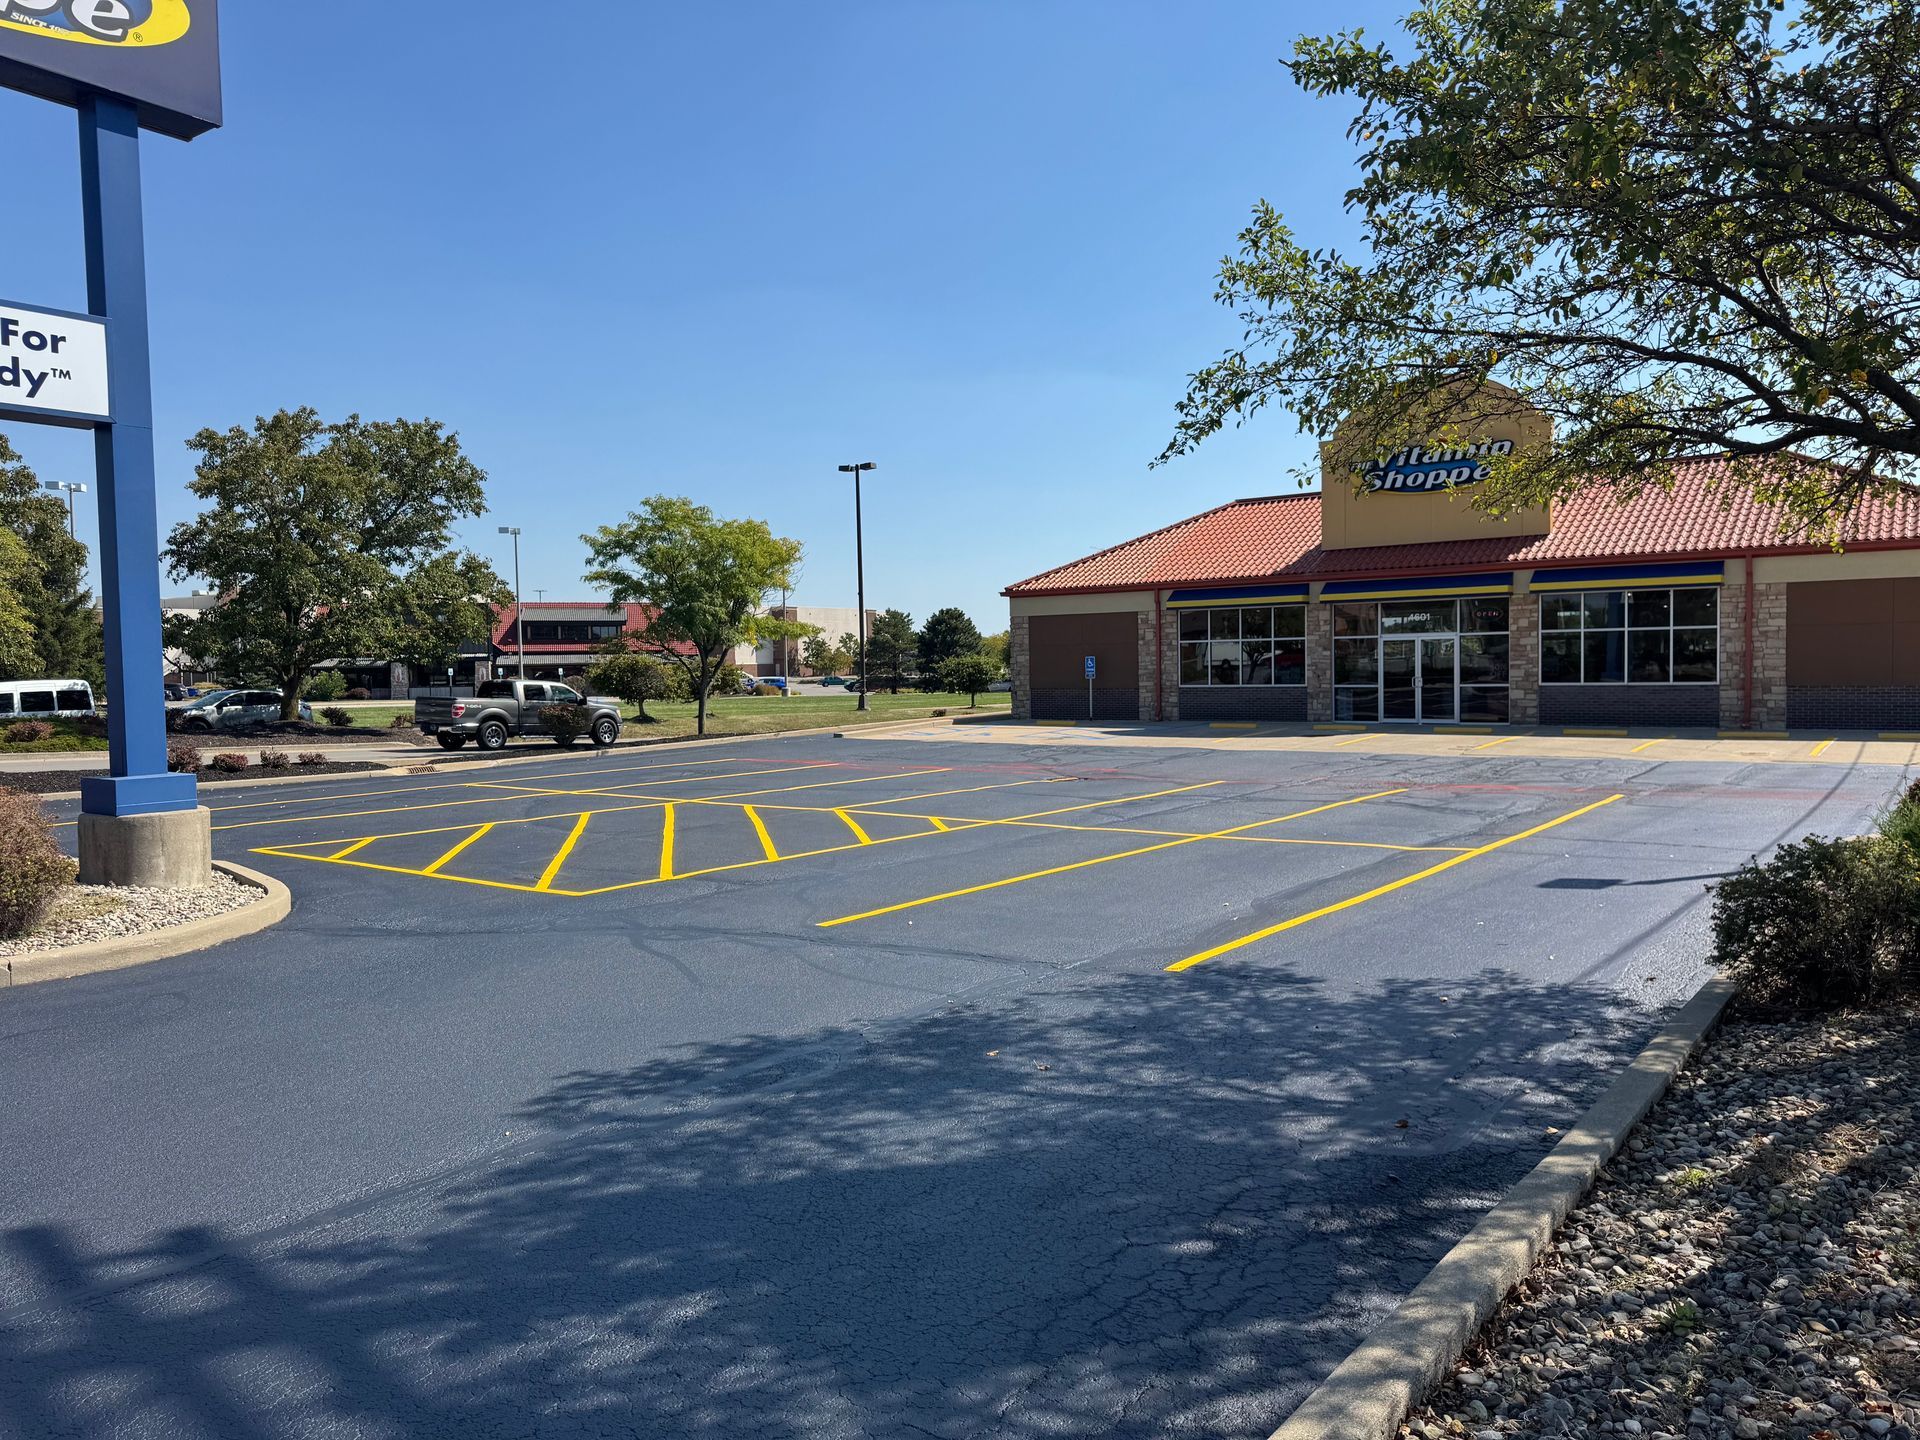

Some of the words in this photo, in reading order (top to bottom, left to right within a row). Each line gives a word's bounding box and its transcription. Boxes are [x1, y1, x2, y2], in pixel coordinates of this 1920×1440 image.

[0, 317, 67, 354] For
[1364, 463, 1493, 492] Shoppe
[1408, 613, 1431, 621] 4601
